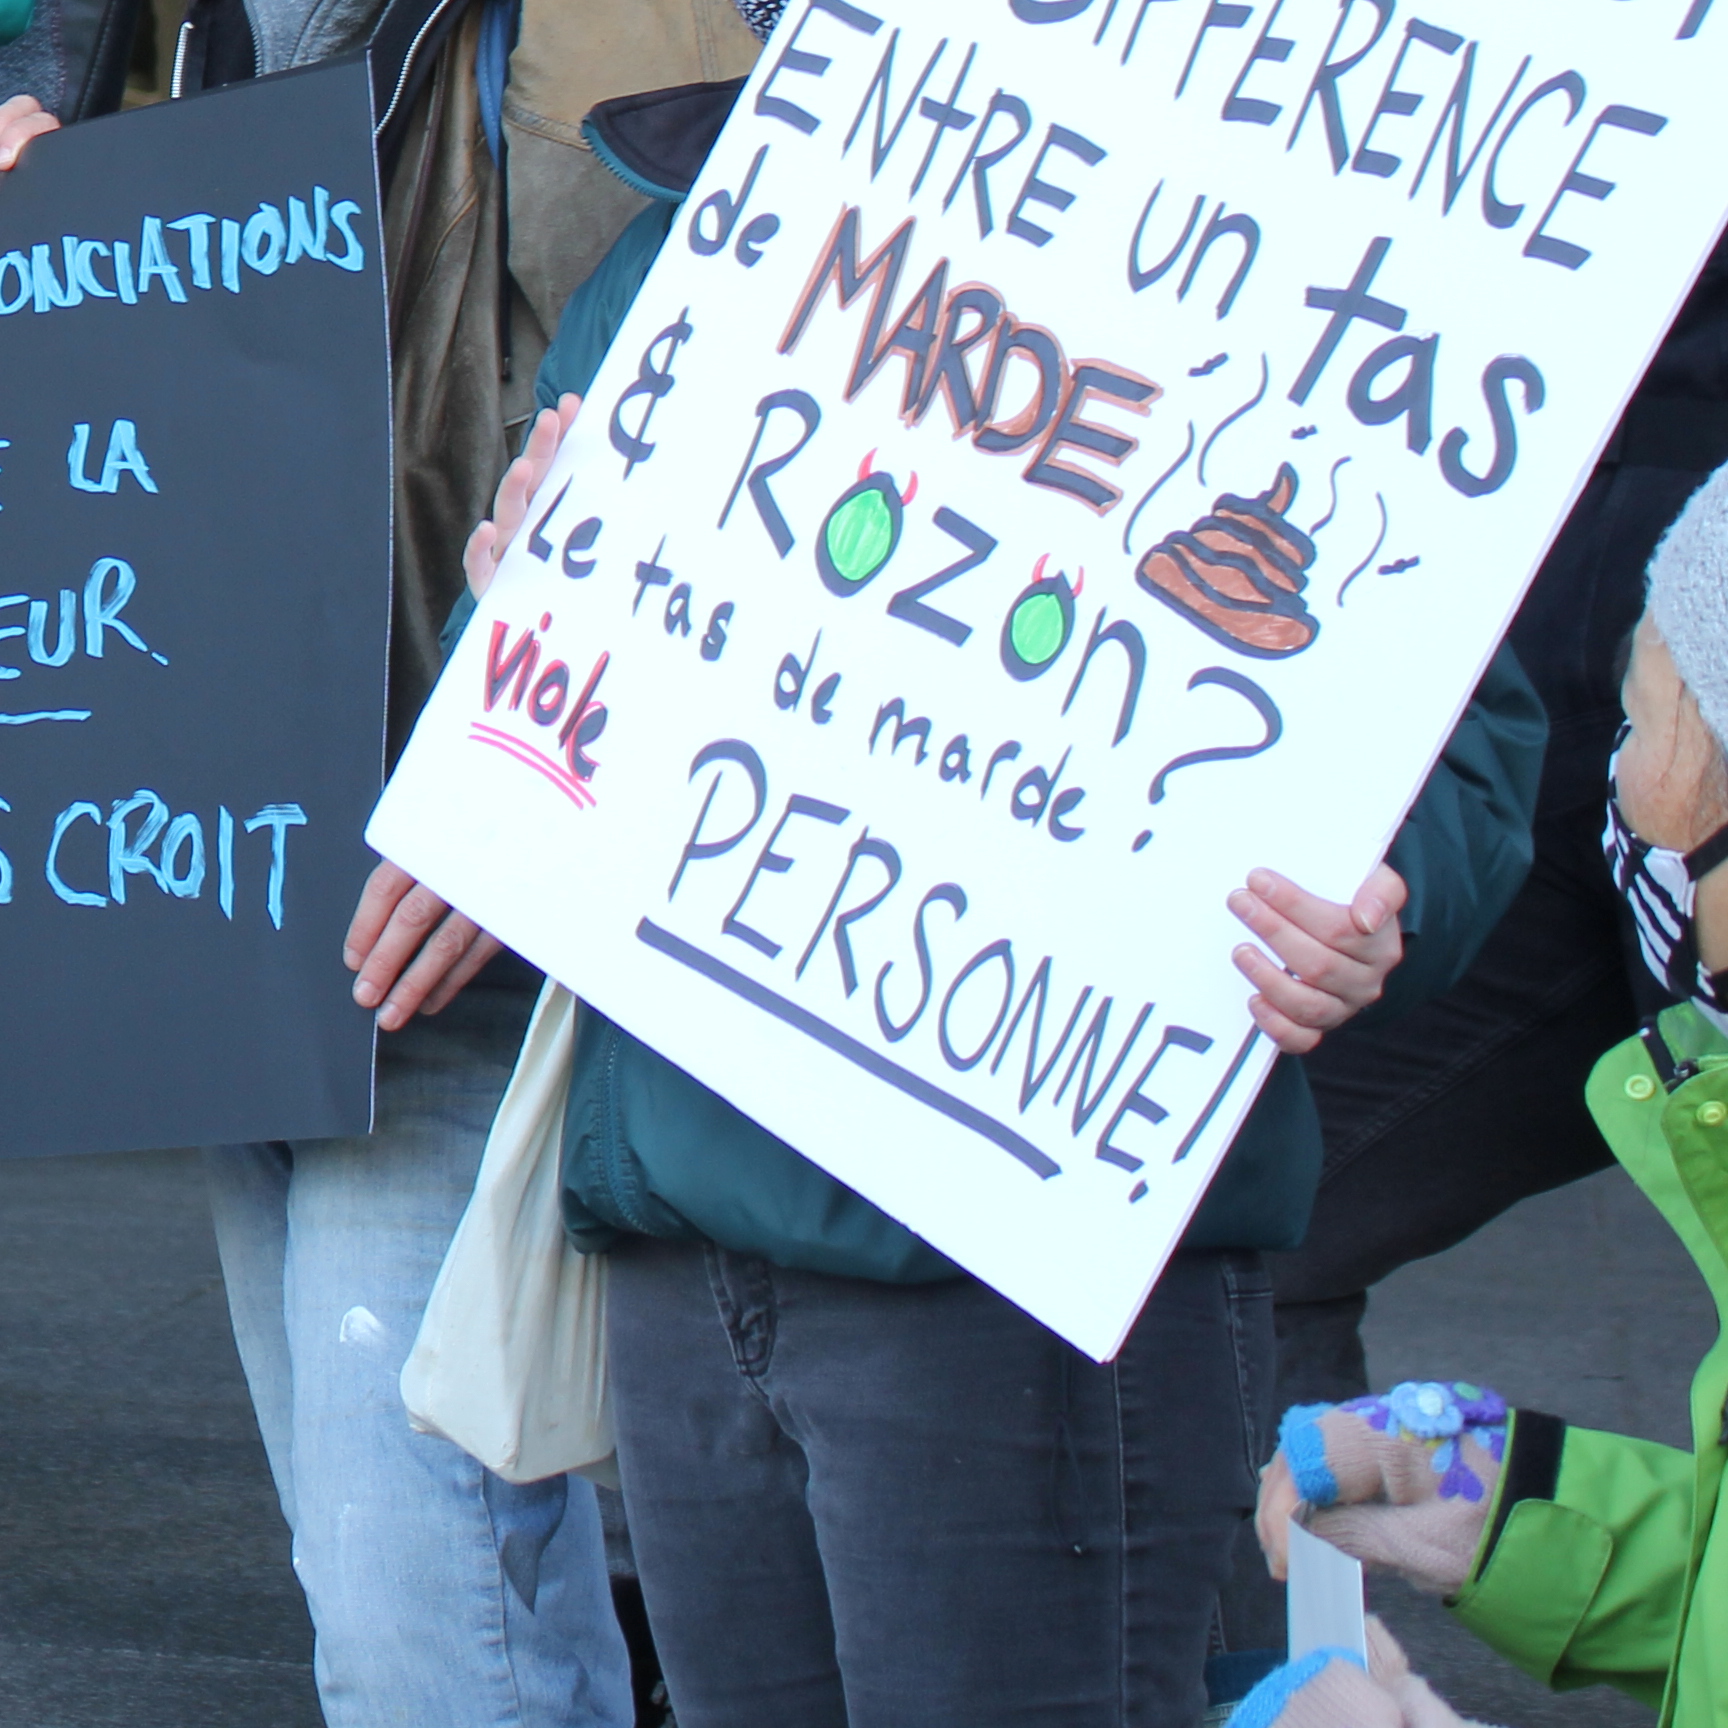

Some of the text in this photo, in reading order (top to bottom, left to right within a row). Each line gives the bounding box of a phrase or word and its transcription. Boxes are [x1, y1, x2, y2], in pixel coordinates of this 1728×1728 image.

[67, 417, 159, 495] LA
[688, 144, 1163, 516] de MARDE
[631, 533, 734, 662] tas
[773, 627, 842, 725] de
[868, 696, 1087, 842] marde
[44, 787, 308, 932] CROIT
[666, 736, 1263, 1204] PERSONNE!
